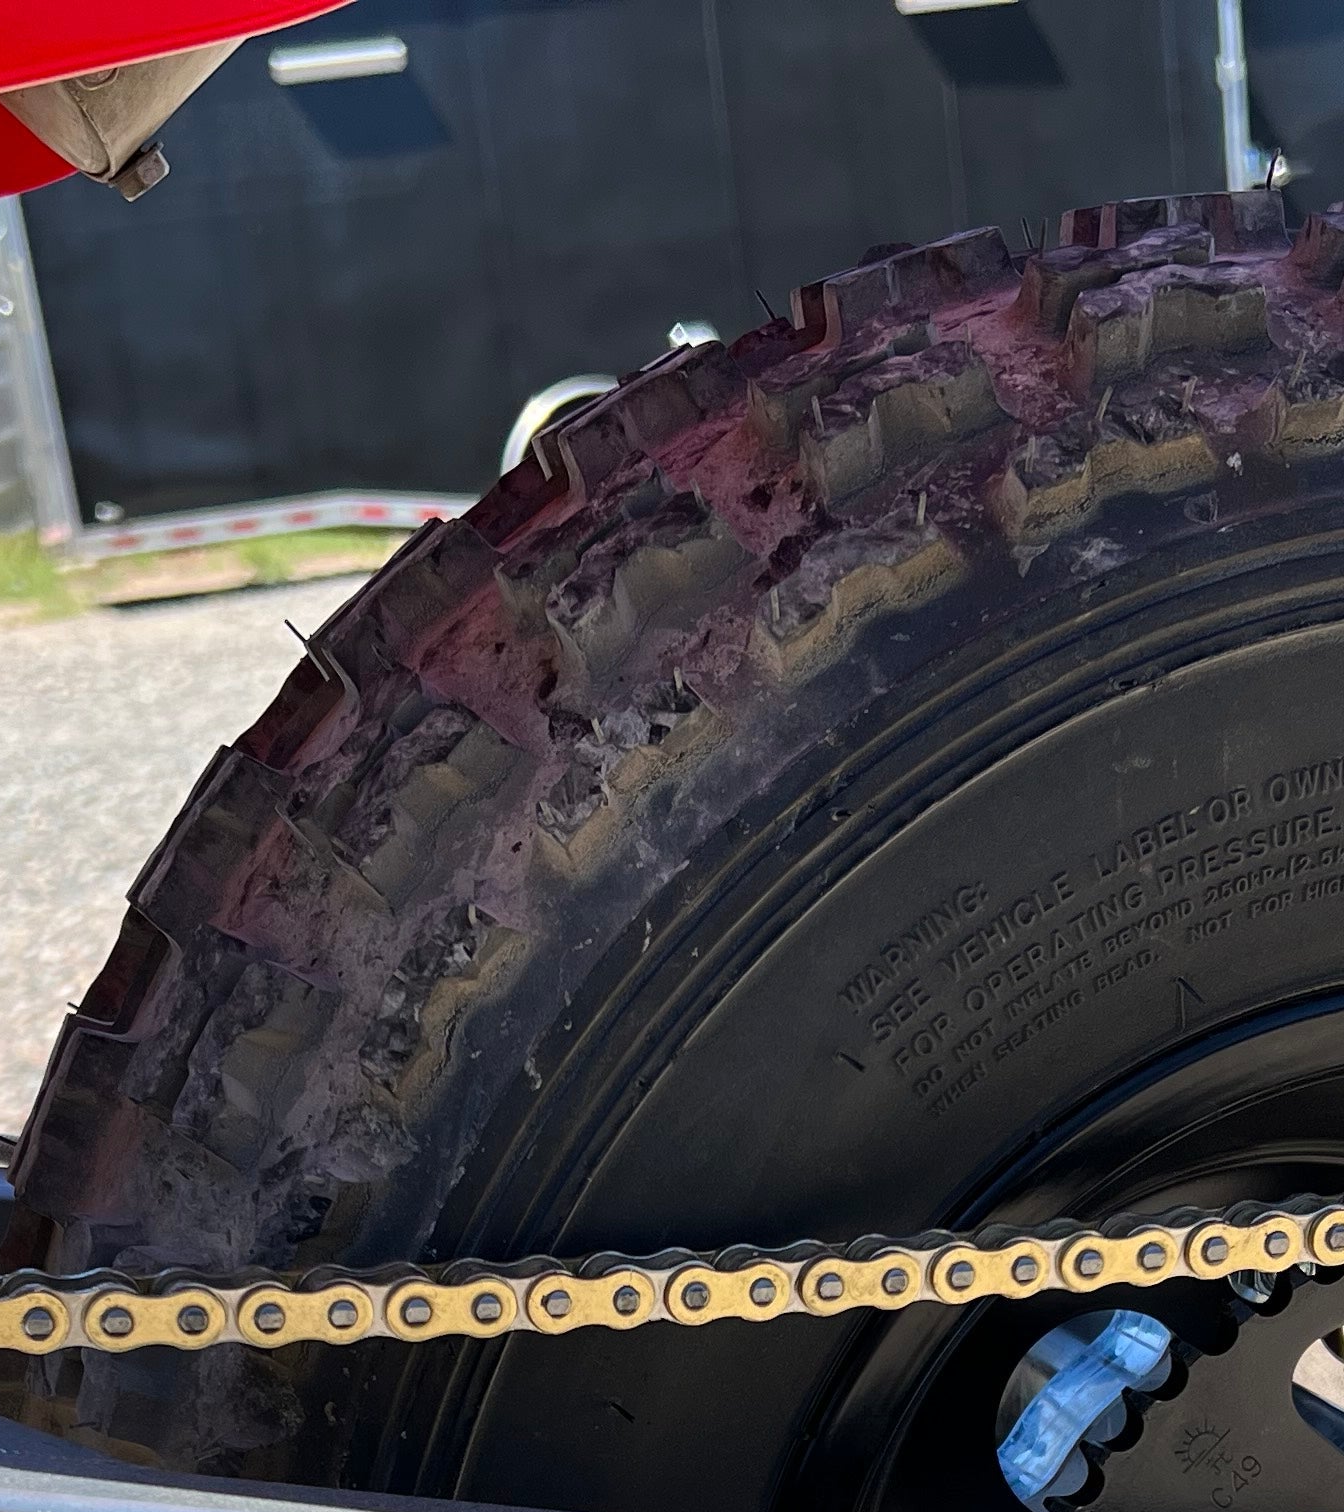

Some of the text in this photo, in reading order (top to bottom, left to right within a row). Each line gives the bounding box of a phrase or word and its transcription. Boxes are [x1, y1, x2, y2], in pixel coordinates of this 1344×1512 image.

[869, 978, 930, 1043] SEE
[939, 870, 1077, 982] VEHICLE
[1089, 811, 1196, 883] LABEL
[1208, 788, 1252, 826] OR
[893, 806, 1342, 1073] FOR OPERATING PRESSURE.
[914, 1064, 944, 1097] DO
[956, 1017, 996, 1064] NOT
[1004, 952, 1094, 1021] INFLATE
[1103, 899, 1194, 952] BEYOND
[928, 1061, 988, 1118] WHEN
[995, 989, 1085, 1062] SEATING
[1186, 909, 1233, 944] NOT
[1249, 890, 1294, 918] FOR
[1212, 1456, 1261, 1508] C49
